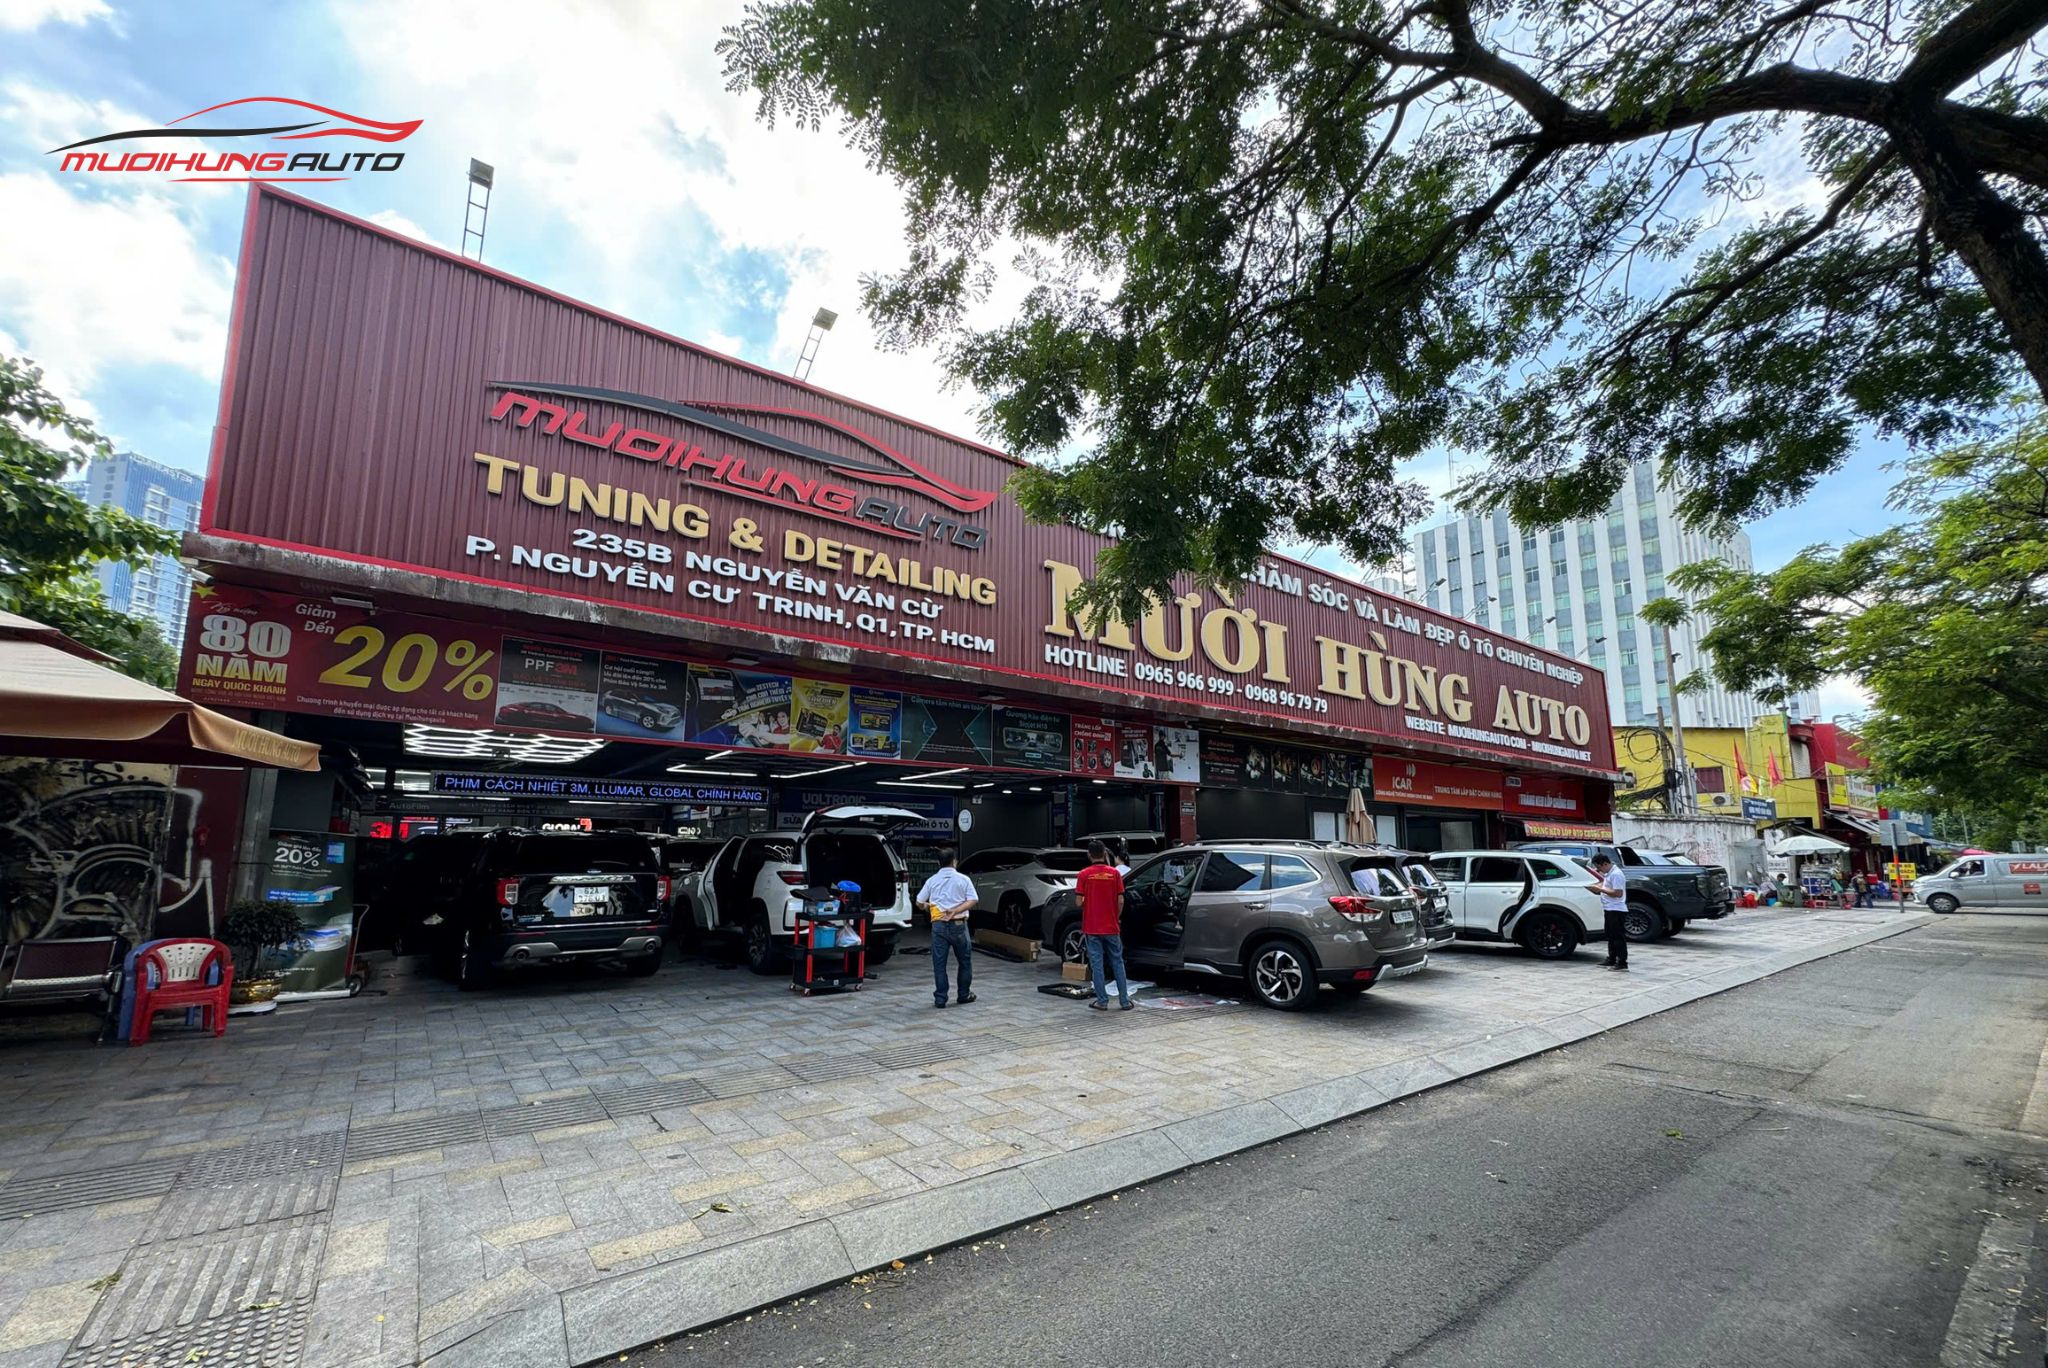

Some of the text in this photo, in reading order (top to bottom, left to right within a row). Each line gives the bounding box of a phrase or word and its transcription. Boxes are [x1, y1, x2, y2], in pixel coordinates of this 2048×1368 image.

[474, 452, 996, 605] TUNING & DETAILING
[466, 535, 500, 561] P.
[512, 544, 674, 593] NGUYỄN
[688, 579, 741, 604] CƯ
[573, 528, 943, 619] 235B NGUYỄN VĂN CỪ
[295, 603, 337, 619] Giảm
[304, 620, 335, 635] Đến
[200, 614, 292, 658] 80
[1308, 581, 1349, 611] SÓC
[1353, 596, 1379, 622] VÀ
[1382, 607, 1420, 635] LÀM
[1425, 622, 1455, 647] ĐẸP
[1458, 630, 1470, 650] Ô
[1473, 637, 1494, 657] TÔ
[1496, 646, 1545, 674] CHUYÊN
[1545, 663, 1584, 688] NGHIỆP
[195, 653, 288, 684] NĂM
[318, 625, 495, 701] 20%
[525, 658, 555, 672] PPF
[1135, 662, 1174, 686] 0965
[1176, 670, 1204, 691] 966
[1208, 678, 1234, 696] 999
[1245, 683, 1277, 705] 0968
[1280, 692, 1295, 708] 96
[1297, 694, 1312, 710] 79
[1313, 697, 1328, 713] 79
[1315, 631, 1473, 722] HÙNG
[1493, 684, 1591, 746] AUTO
[445, 777, 480, 790] PHIM
[485, 777, 524, 791] CÁCH
[528, 779, 567, 793] NHIỆT
[594, 783, 645, 796] LLUMAR,
[650, 786, 694, 799] GLOBAL
[697, 786, 730, 801] CHÍNH
[733, 786, 762, 802] HÃNG
[1392, 776, 1412, 791] ICAR
[274, 847, 320, 867] 20%
